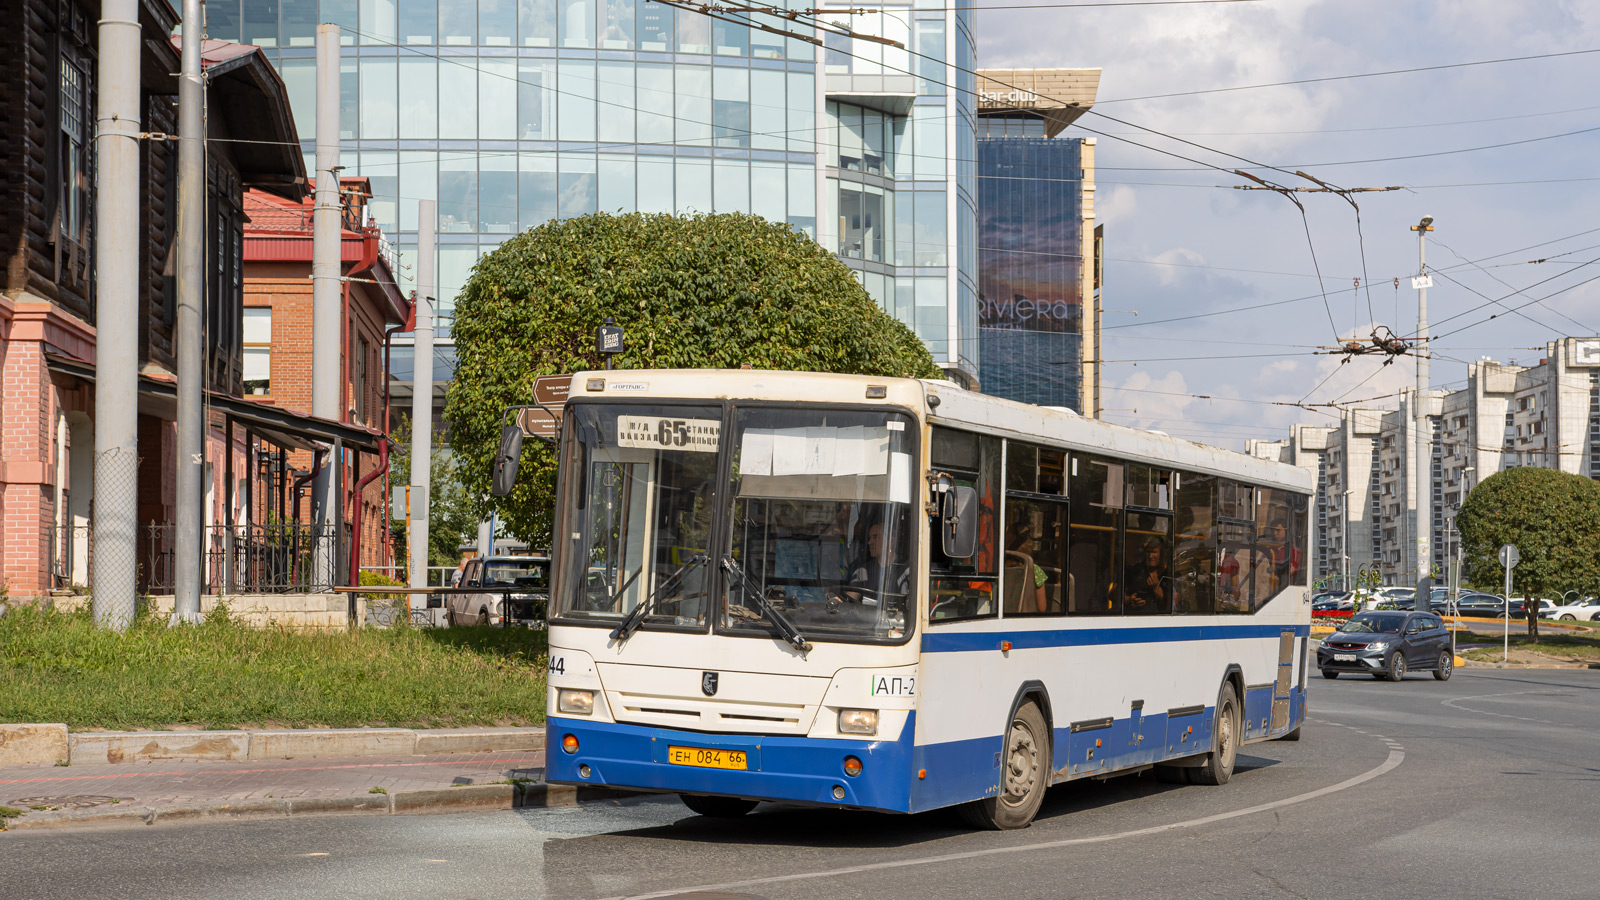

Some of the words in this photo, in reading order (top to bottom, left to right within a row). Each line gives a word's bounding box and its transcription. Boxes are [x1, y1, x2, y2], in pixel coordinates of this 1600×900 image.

[979, 88, 1038, 102] bar-club
[629, 422, 649, 432] Ж/Д
[658, 419, 687, 447] 65
[620, 432, 659, 442] ВОКЗАЛ
[876, 677, 915, 695] АП-2
[696, 750, 721, 765] 084
[729, 752, 742, 763] 66
